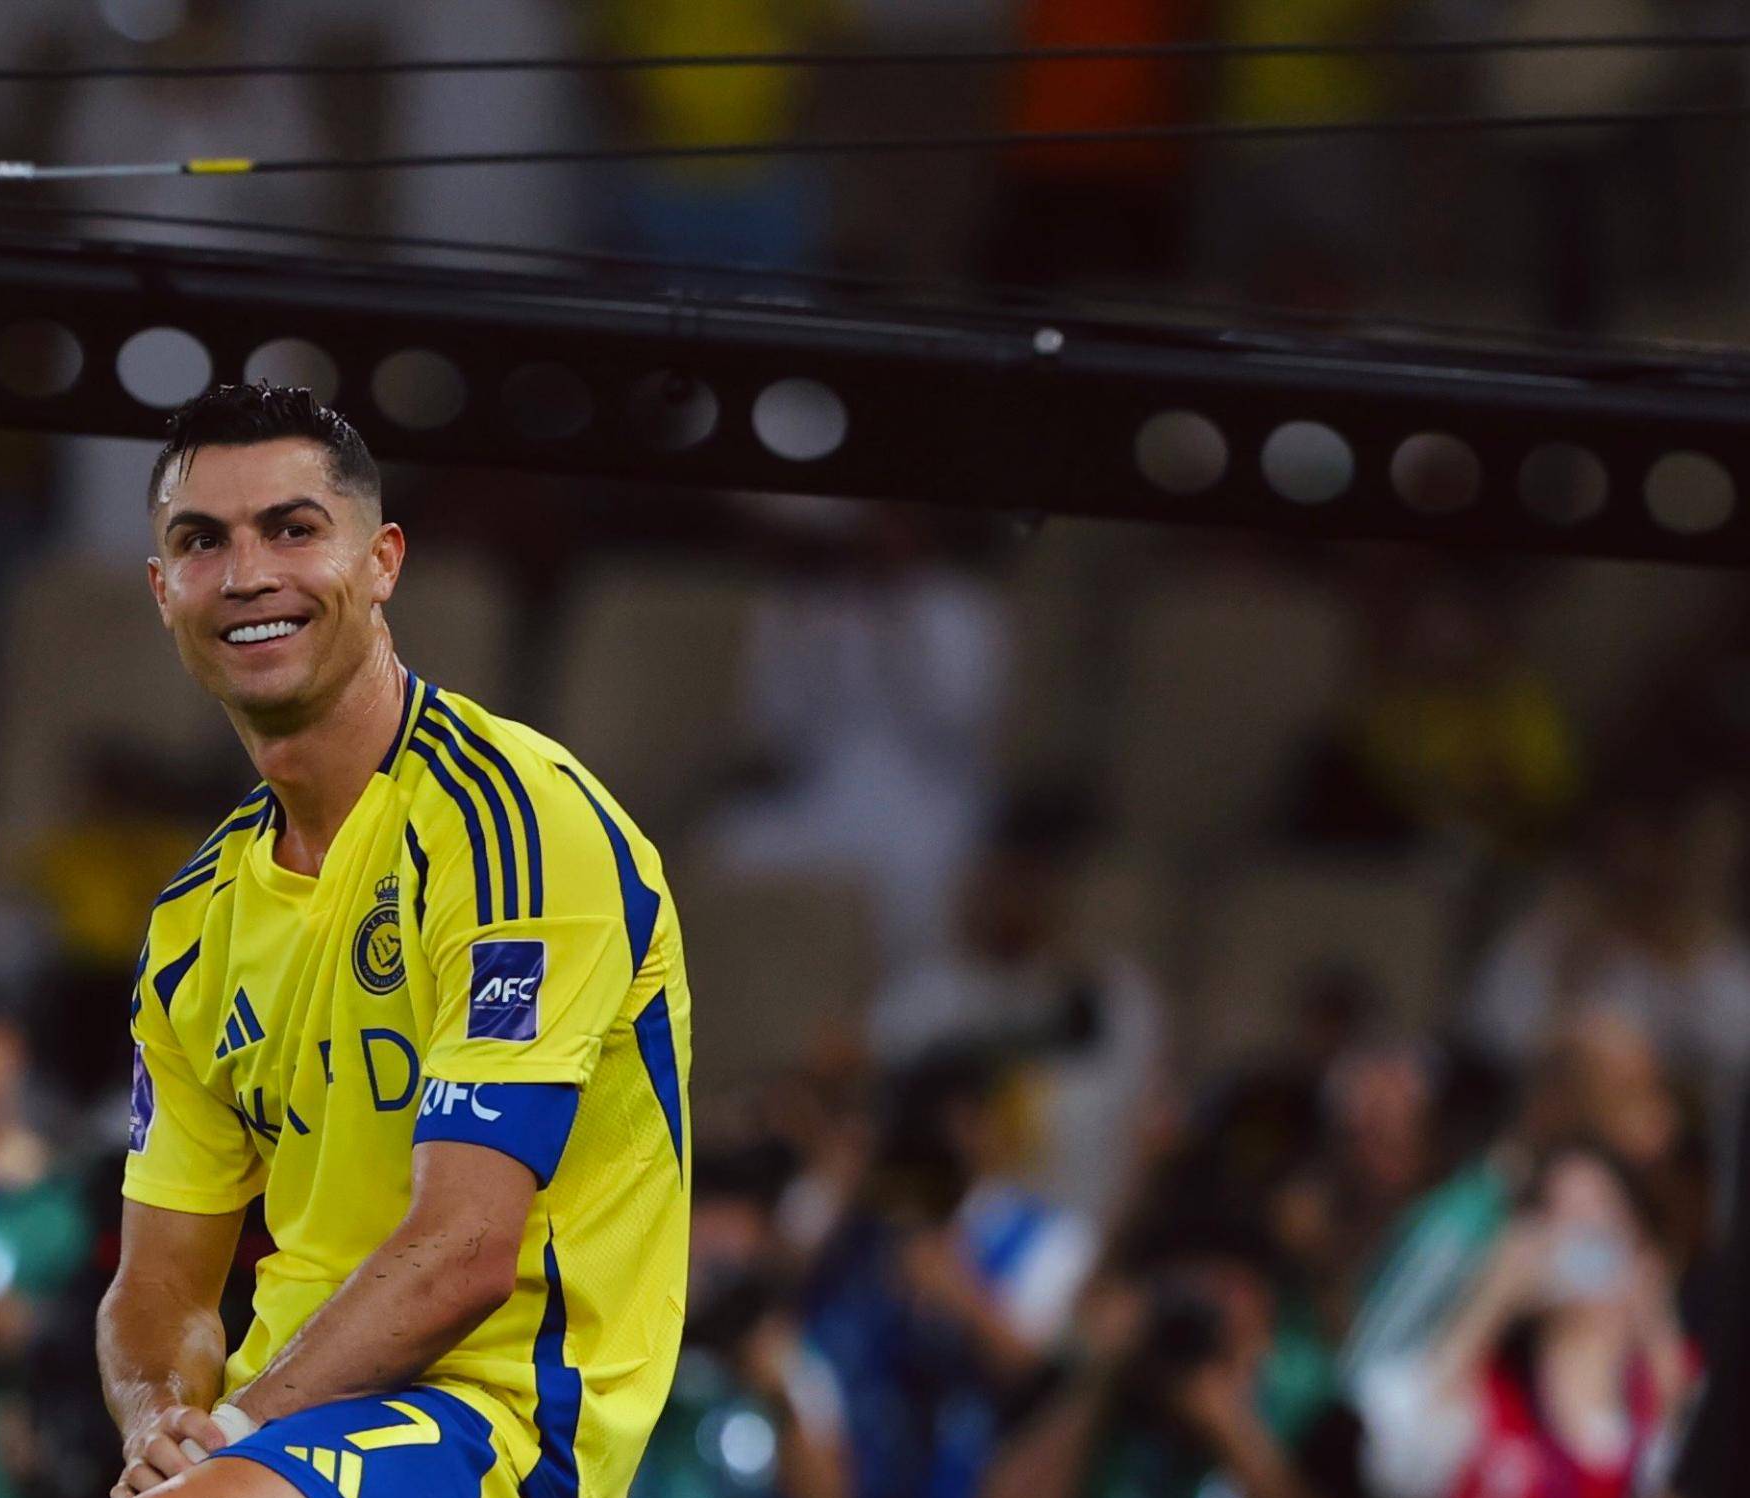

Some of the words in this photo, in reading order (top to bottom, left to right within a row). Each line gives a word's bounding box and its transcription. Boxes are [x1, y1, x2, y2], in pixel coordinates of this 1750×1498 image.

[473, 977, 535, 1002] AFC
[416, 1078, 503, 1122] AFC
[343, 1400, 441, 1452] 7
